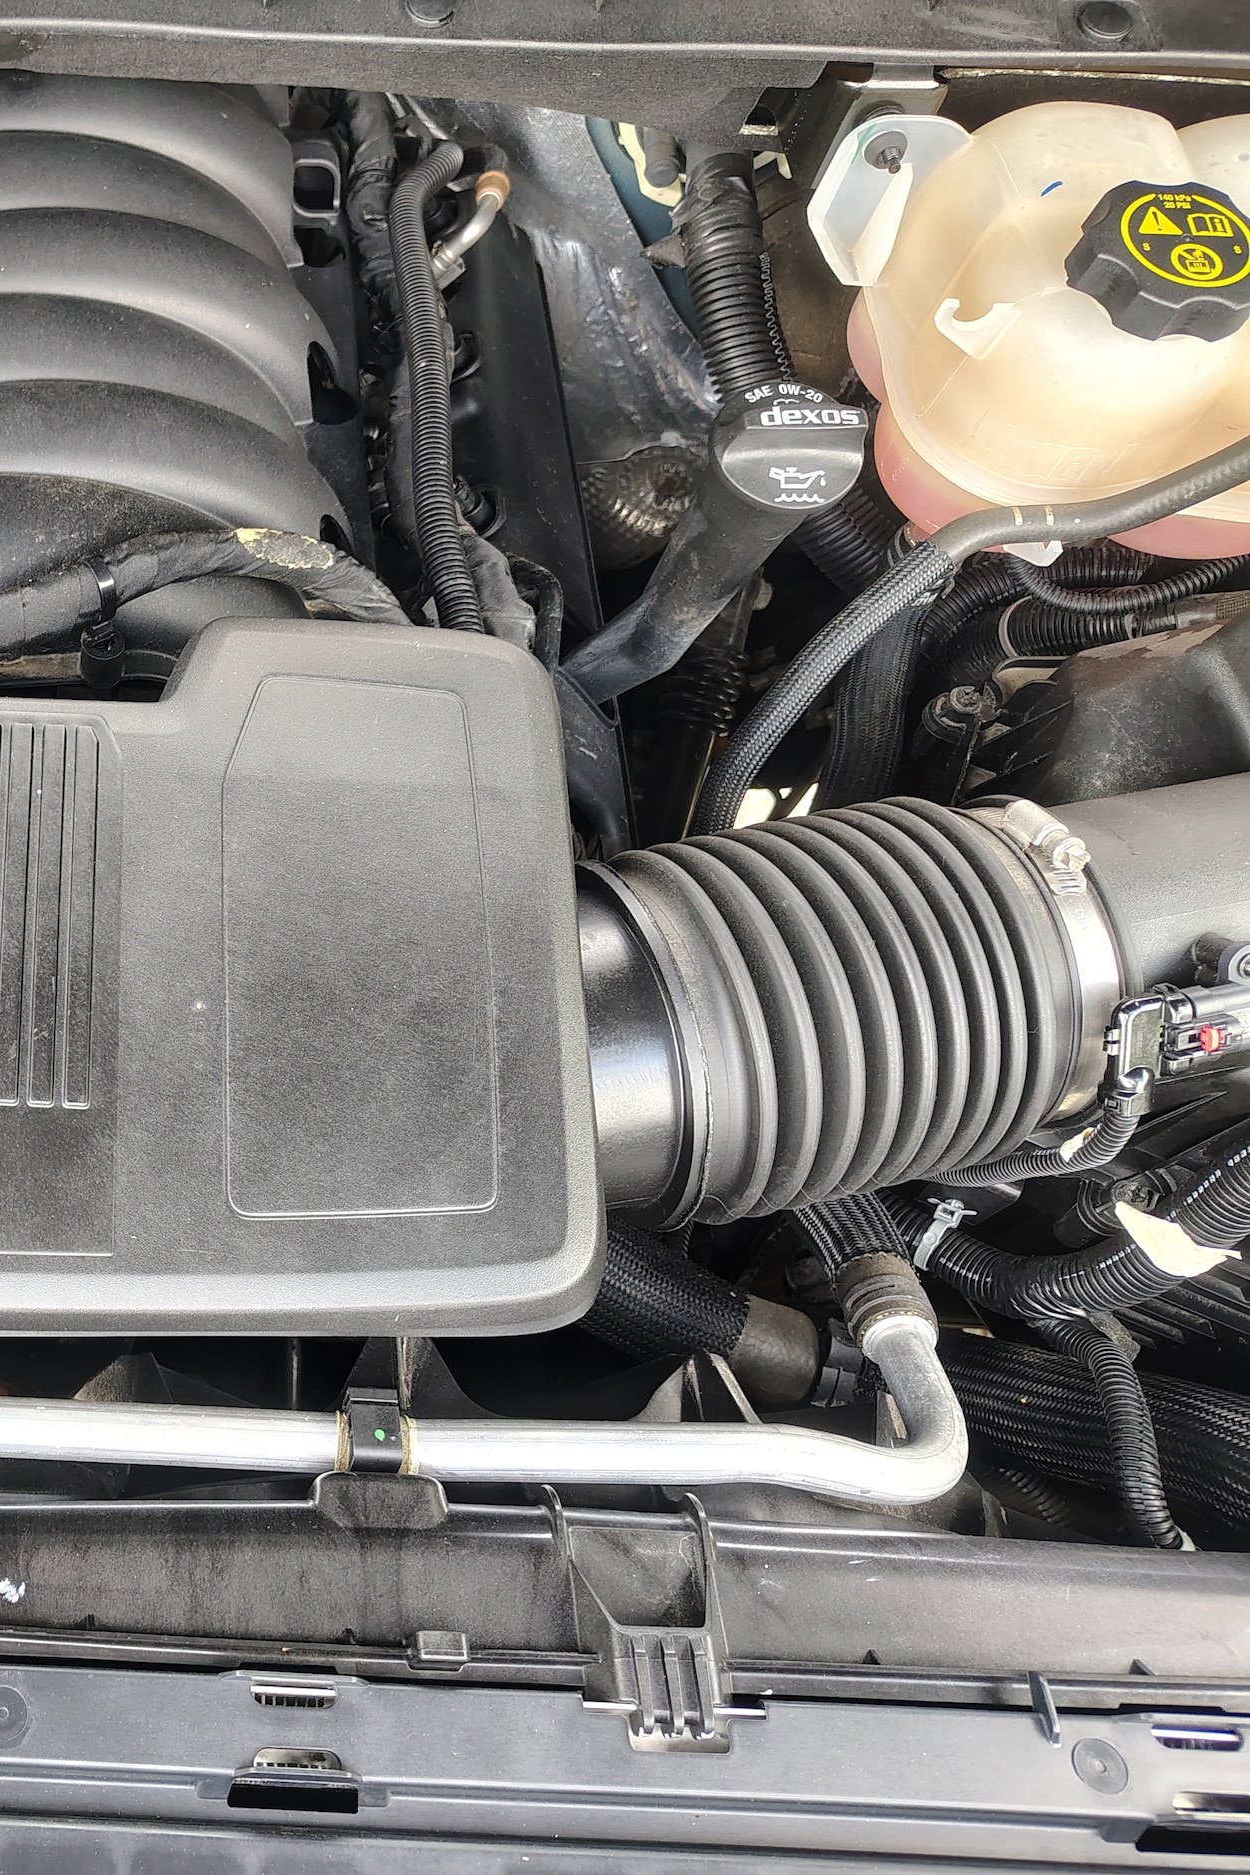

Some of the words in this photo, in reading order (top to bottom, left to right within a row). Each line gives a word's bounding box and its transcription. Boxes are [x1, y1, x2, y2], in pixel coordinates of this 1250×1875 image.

[1163, 201, 1176, 209] 20
[1176, 201, 1192, 209] PSI
[744, 385, 773, 403] SAE
[778, 384, 823, 403] 0W-20
[760, 406, 860, 426] dexos
